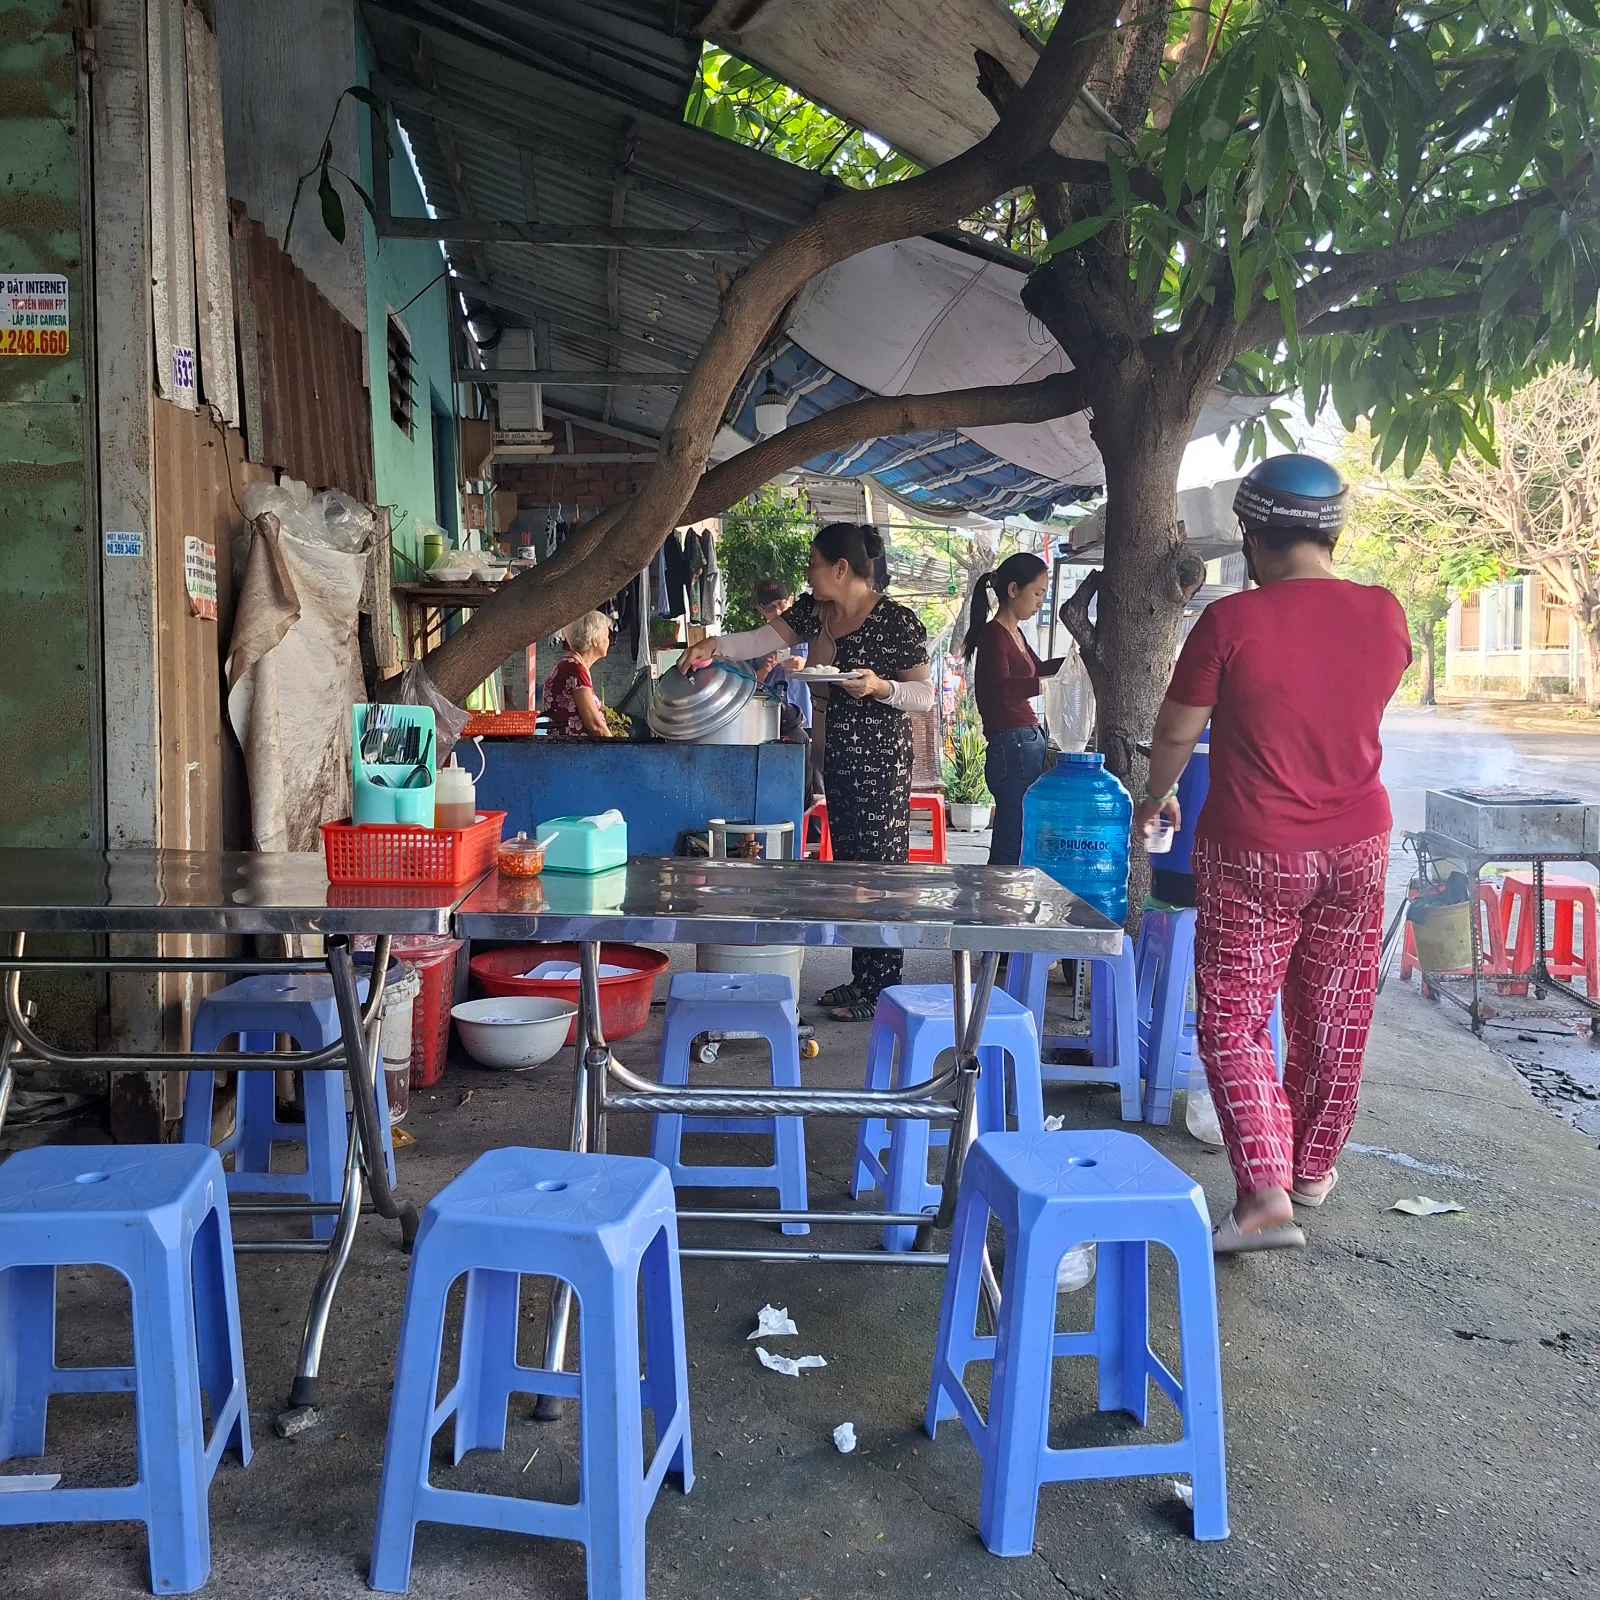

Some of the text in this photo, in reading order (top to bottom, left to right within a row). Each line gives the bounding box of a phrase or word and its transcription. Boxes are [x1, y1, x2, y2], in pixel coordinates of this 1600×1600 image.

[7, 278, 23, 296] ĐẶT
[26, 281, 66, 294] INTERNET
[38, 297, 53, 310] HÌNH
[55, 299, 66, 310] FPT
[40, 315, 66, 326] CAMERA
[865, 717, 883, 725] Dior
[864, 765, 881, 773] Dior
[868, 812, 886, 820] Dior
